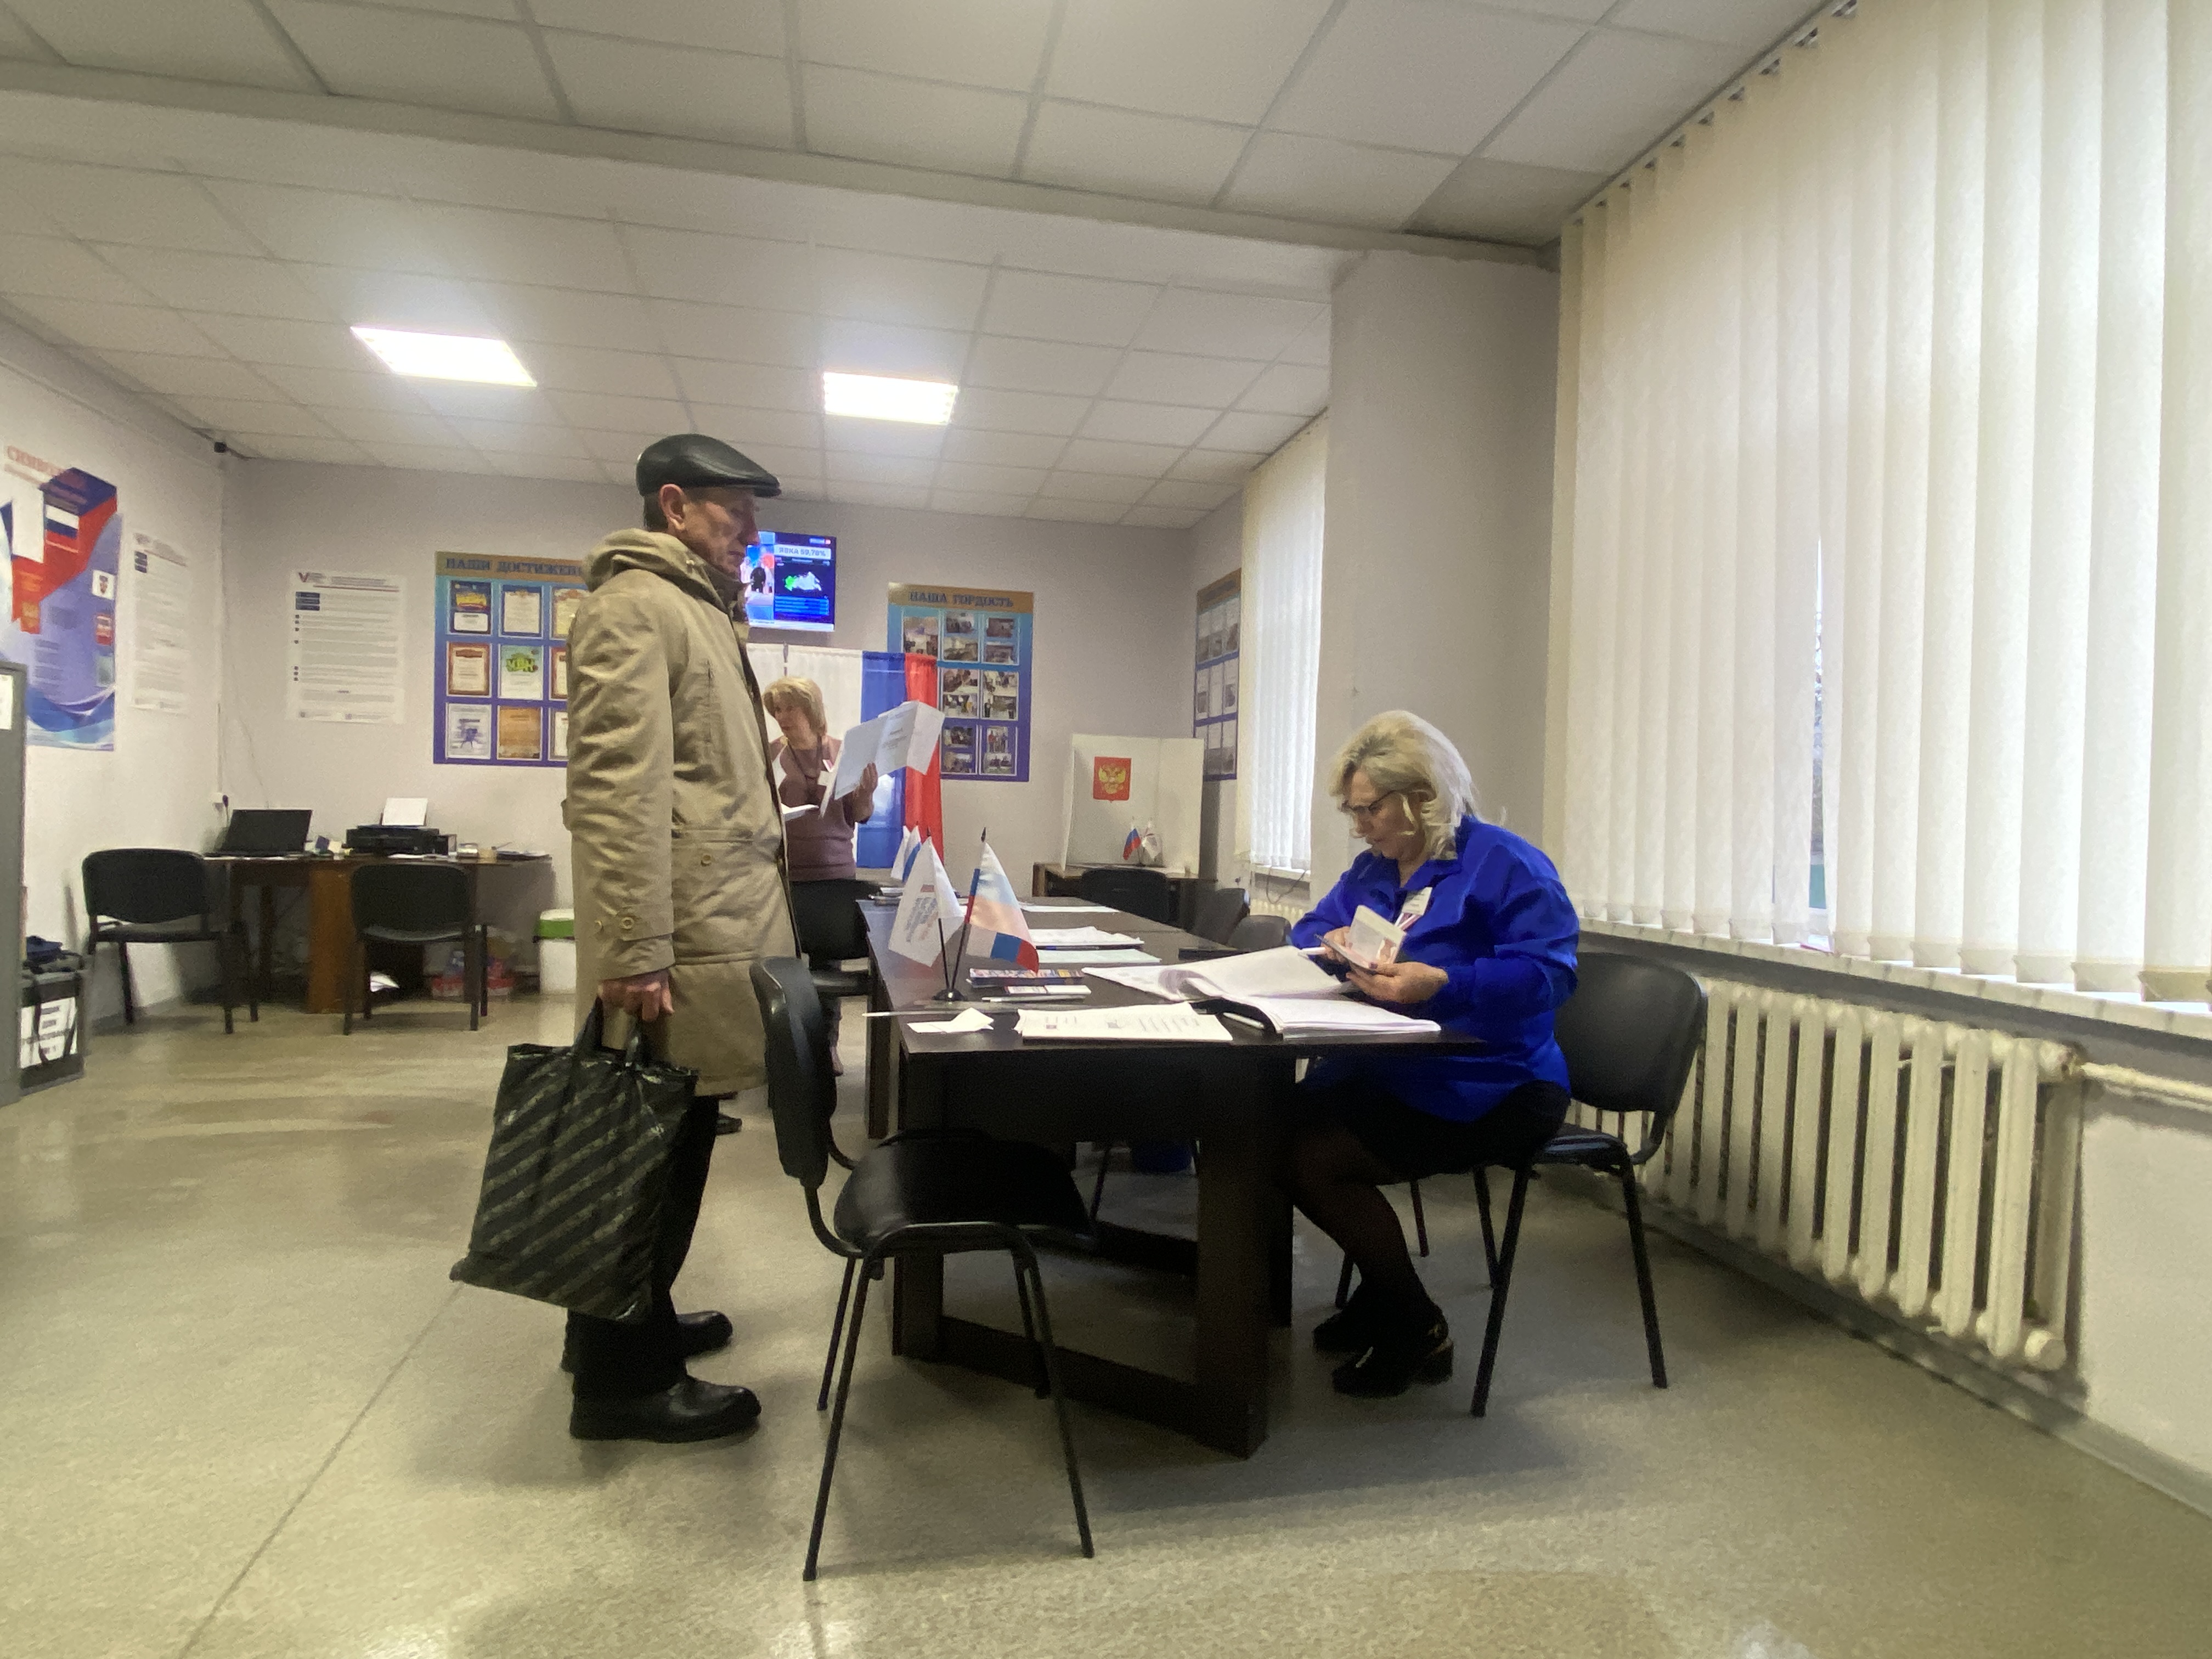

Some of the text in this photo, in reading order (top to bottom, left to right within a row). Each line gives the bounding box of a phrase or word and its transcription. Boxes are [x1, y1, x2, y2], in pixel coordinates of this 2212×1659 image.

[445, 557, 582, 575] НАШИ ДОСТИЖЕН
[909, 591, 1014, 607] НАША ГОРДОСТЬ
